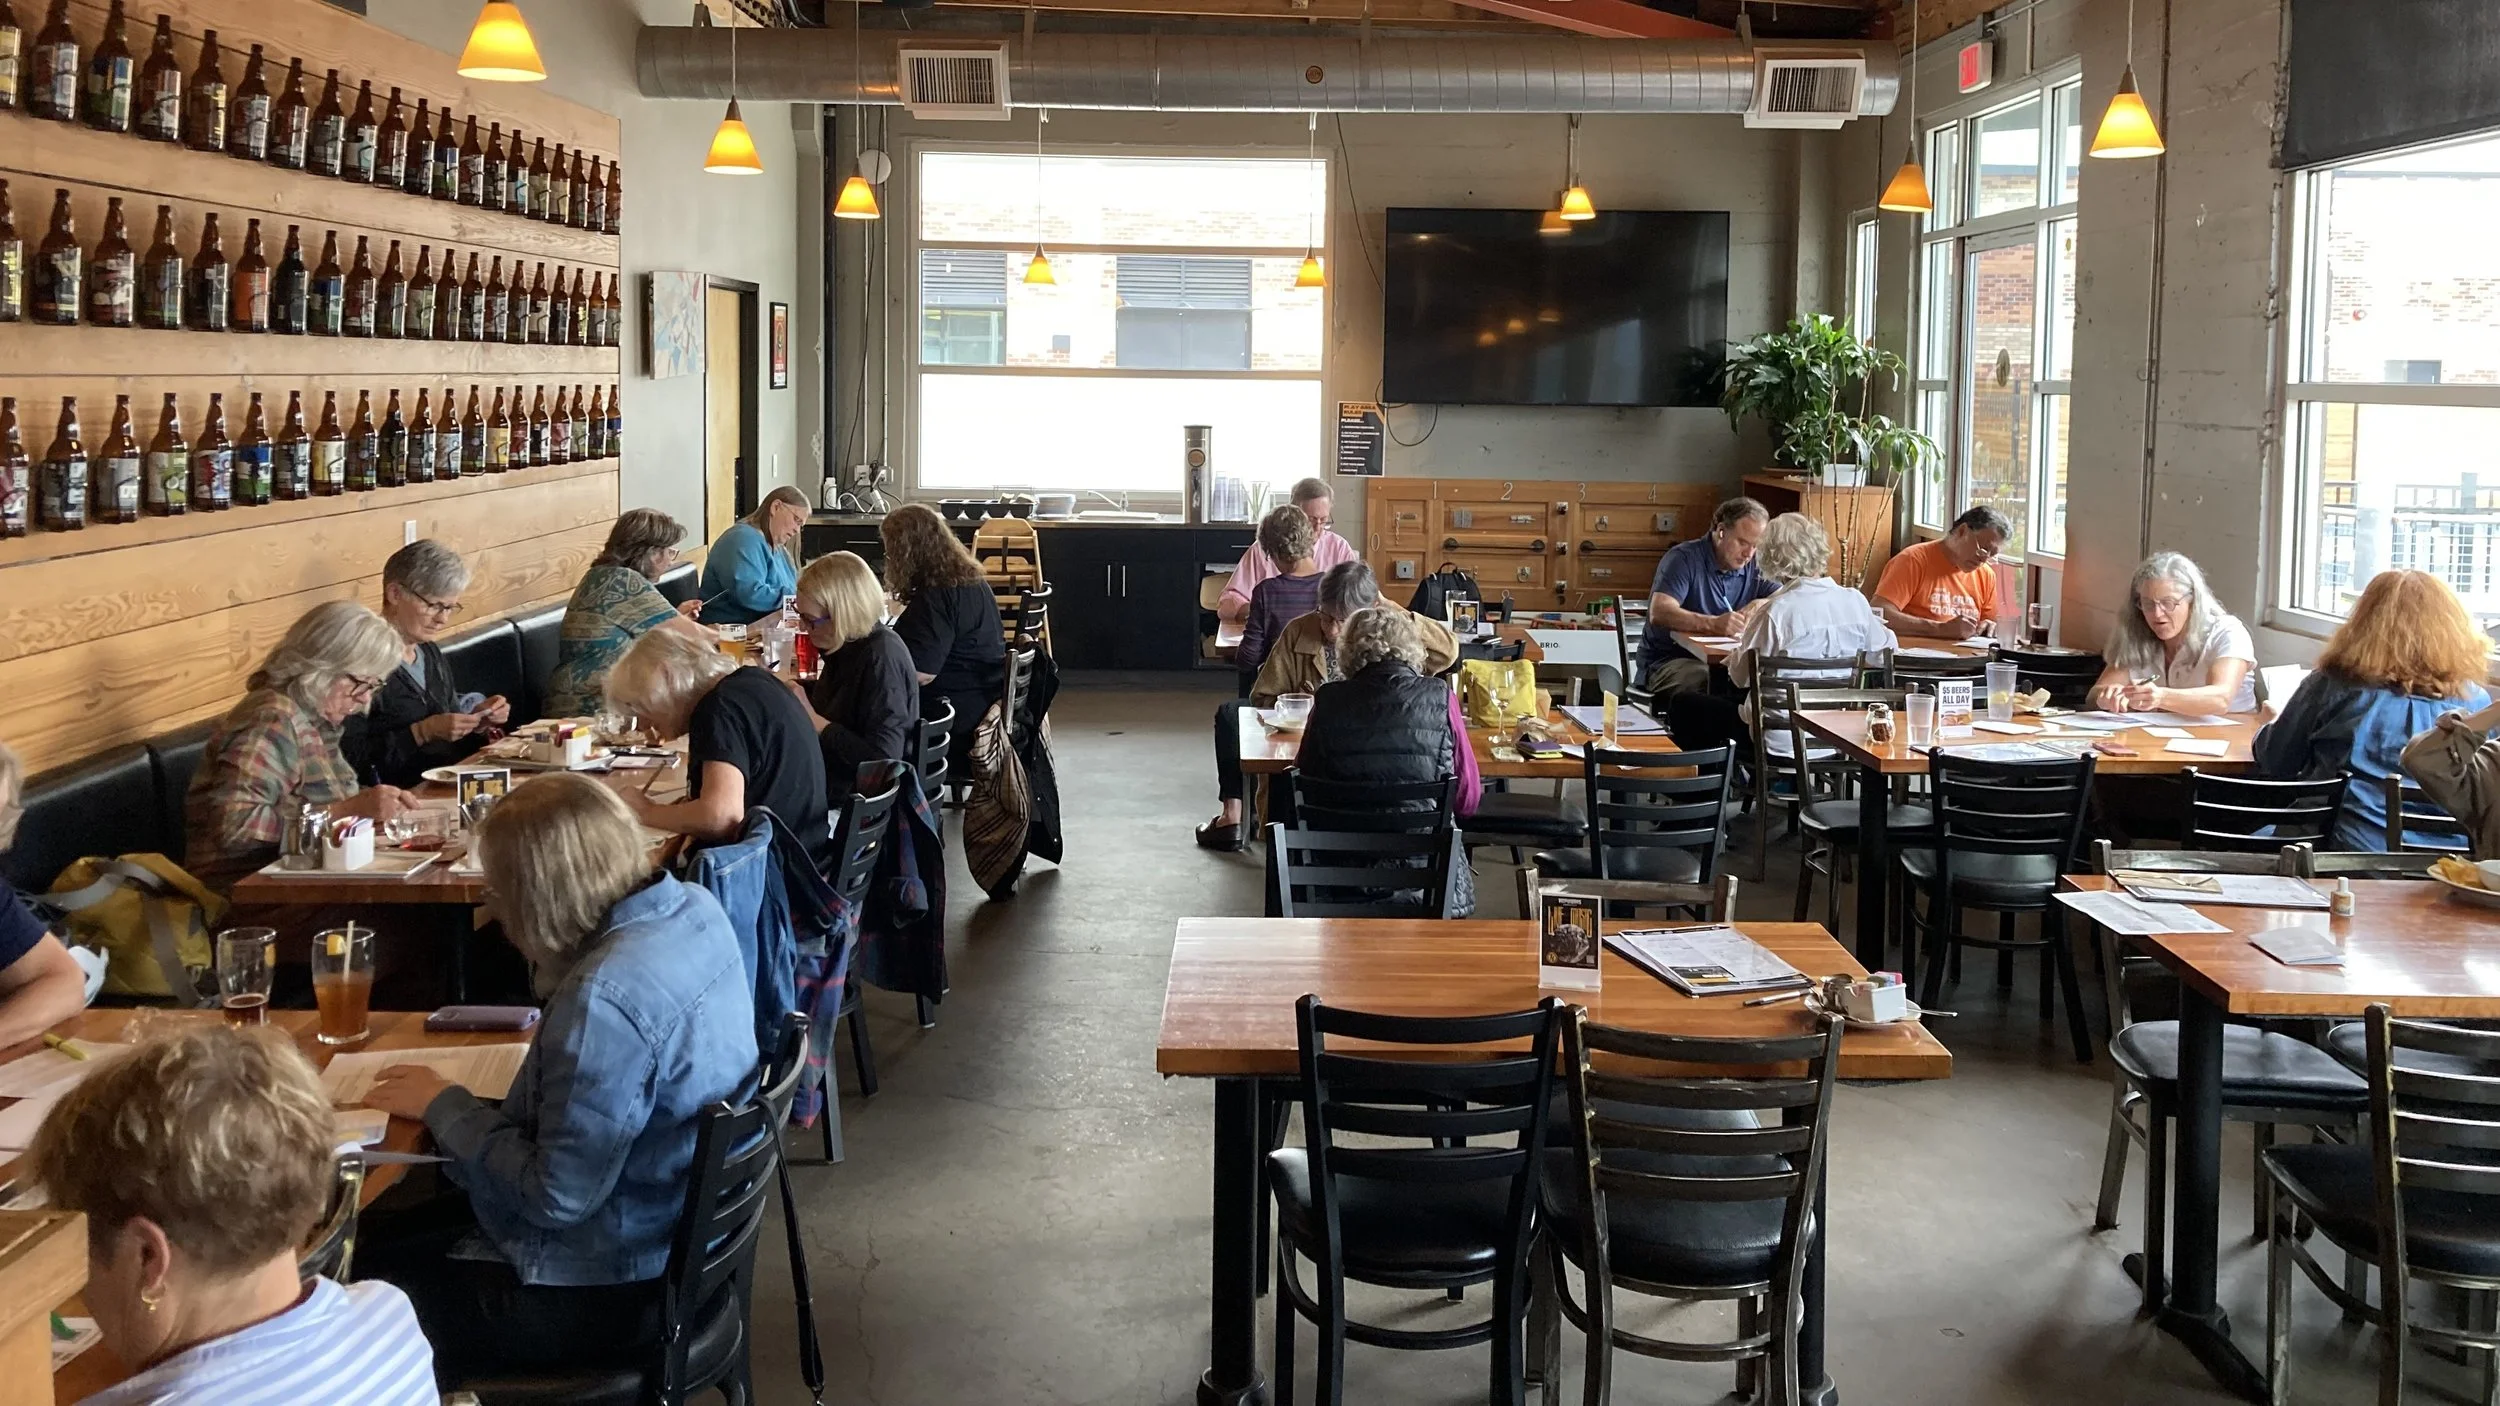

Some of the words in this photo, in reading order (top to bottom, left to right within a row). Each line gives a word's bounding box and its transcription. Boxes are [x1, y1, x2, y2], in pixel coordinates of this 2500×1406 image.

[1433, 480, 1438, 499] 1
[1500, 481, 1514, 501] 2
[1578, 482, 1586, 502] 3
[1648, 483, 1657, 504] 4
[1574, 591, 1585, 609] 7
[1942, 686, 1951, 695] $5
[1951, 686, 1971, 695] BEERS
[1942, 695, 1955, 705] ALL
[1956, 695, 1970, 704] DAY
